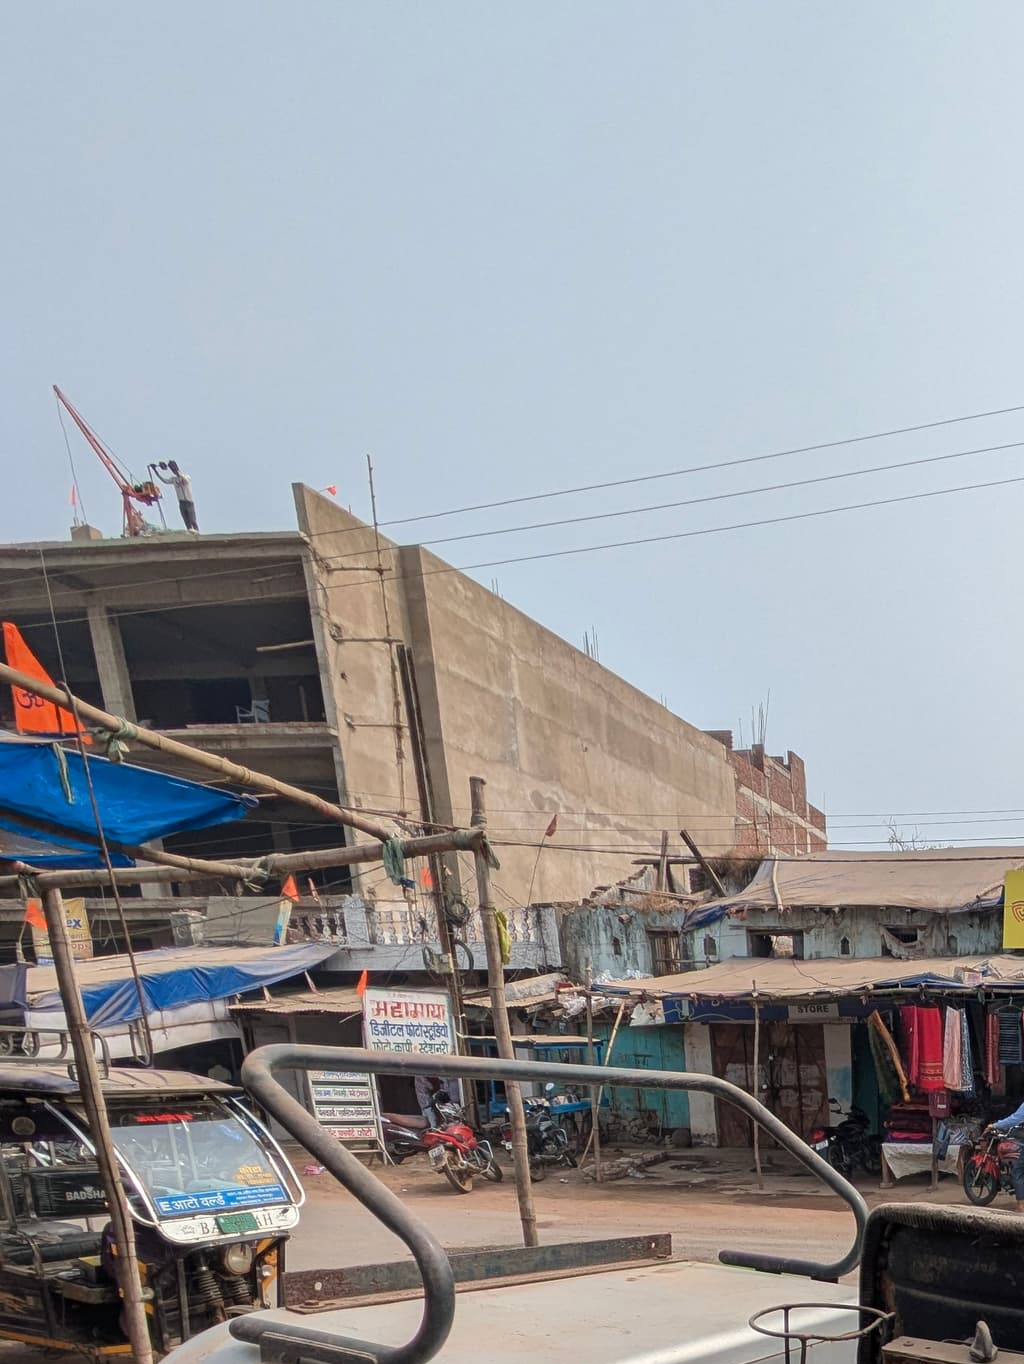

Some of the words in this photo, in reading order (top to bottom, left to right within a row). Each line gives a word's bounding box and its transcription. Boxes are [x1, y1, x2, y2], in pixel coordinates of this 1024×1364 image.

[373, 1000, 446, 1020] महामाया
[797, 1005, 830, 1013] STORE
[65, 1190, 106, 1201] BADSHA
[172, 1195, 199, 1211] आटो
[200, 1212, 273, 1235] BAAH
